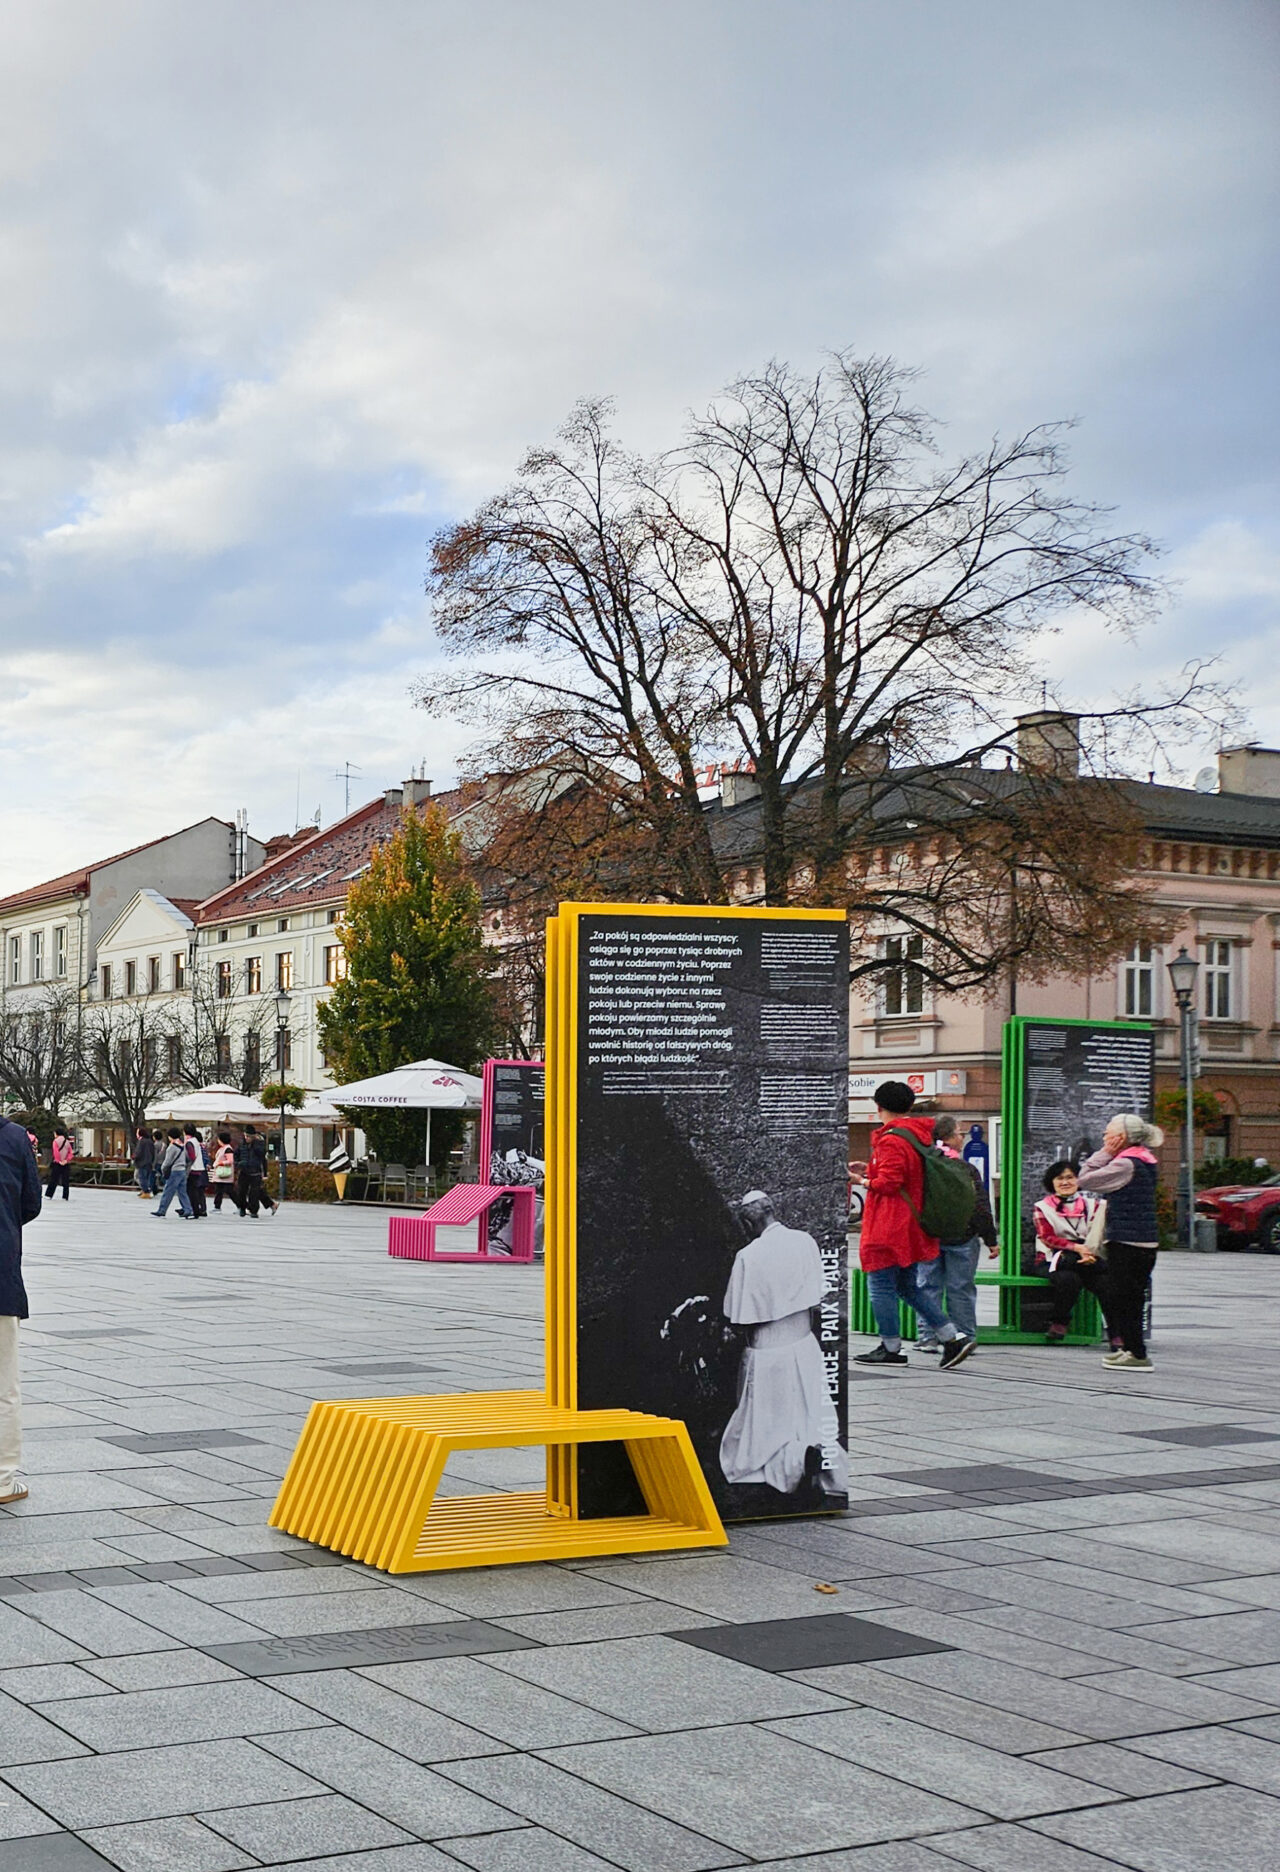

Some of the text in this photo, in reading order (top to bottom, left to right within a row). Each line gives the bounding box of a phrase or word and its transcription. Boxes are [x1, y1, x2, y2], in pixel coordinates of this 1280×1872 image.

[605, 931, 628, 943] pokój
[630, 934, 640, 943] są
[642, 932, 702, 944] odpowiedzialni
[590, 945, 742, 957] osiąga się go poprzez tysiąc drobnych
[589, 958, 615, 967] aktów
[625, 958, 675, 970] codziennym
[701, 959, 731, 971] Poprzez
[590, 971, 613, 982] swoje
[615, 972, 657, 981] codzienne
[658, 972, 679, 983] życie
[686, 972, 713, 984] innymi
[589, 985, 613, 994] ludzie
[615, 985, 654, 997] dokonują
[589, 999, 726, 1011] pokoju lub przeciw niemu. Sprawę
[589, 1013, 716, 1024] pokoju powierzamy szczególnie
[627, 1027, 644, 1038] Oby
[646, 1027, 673, 1036] młodzi
[675, 1027, 698, 1036] ludzie
[700, 1027, 732, 1038] pomogli
[589, 1040, 621, 1049] uwolnić
[623, 1040, 653, 1051] historię
[655, 1040, 665, 1049] od
[589, 1055, 599, 1064] po
[602, 1053, 632, 1064] których
[635, 1053, 659, 1064] błądzi
[378, 1096, 408, 1104] COFFEE
[821, 1248, 839, 1291] PACE
[821, 1301, 839, 1342] PAIX
[821, 1350, 839, 1405] PEACE
